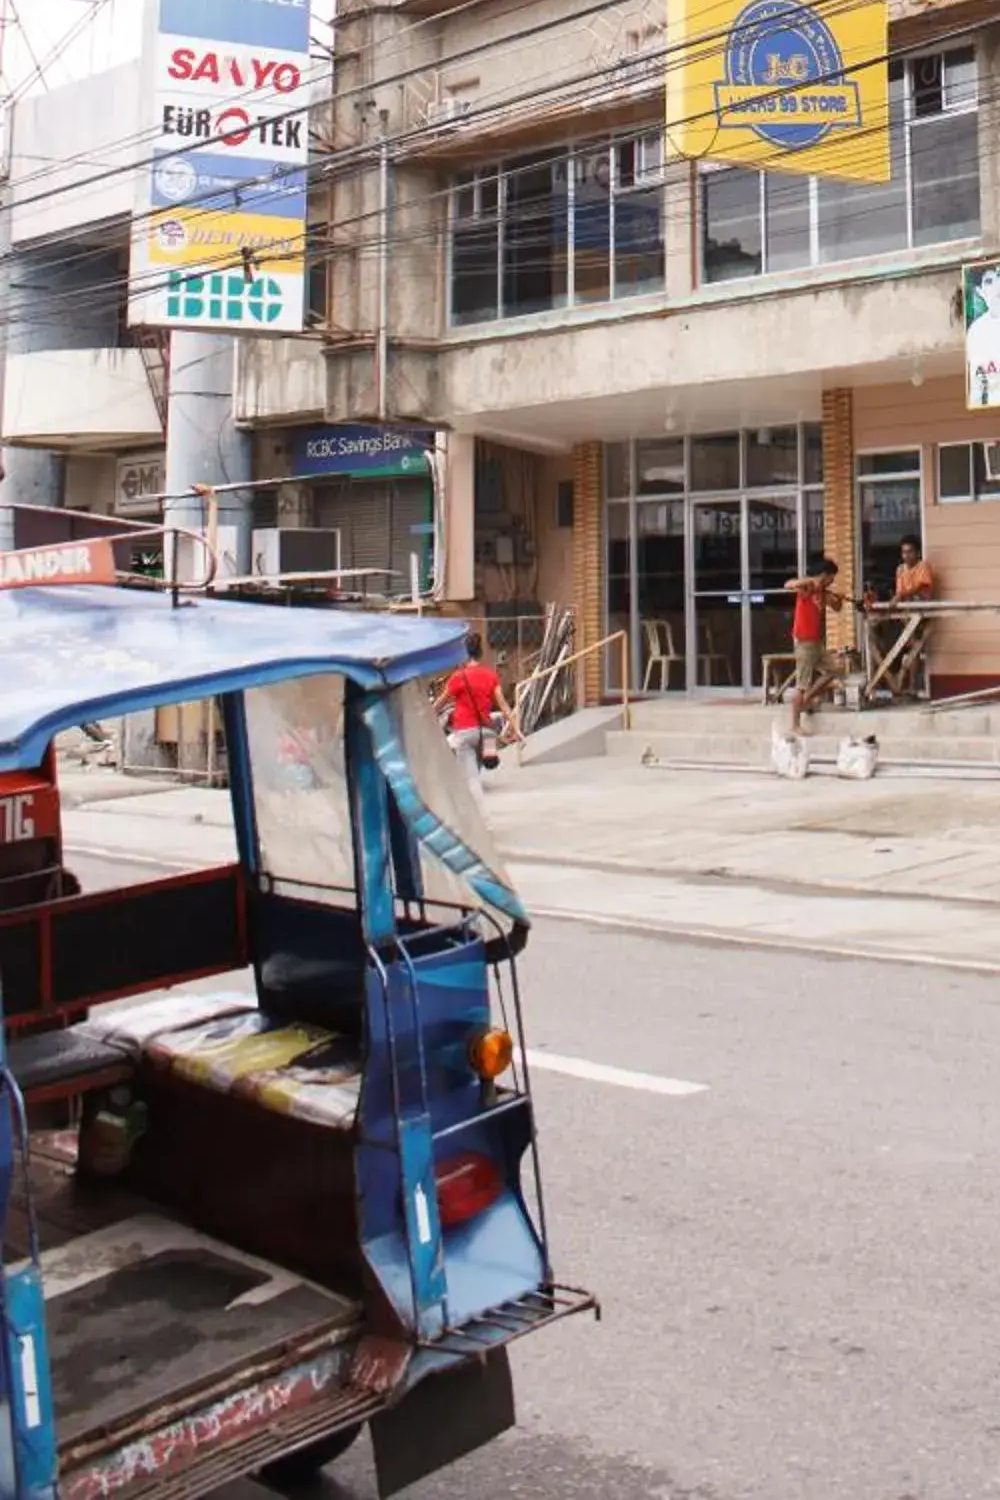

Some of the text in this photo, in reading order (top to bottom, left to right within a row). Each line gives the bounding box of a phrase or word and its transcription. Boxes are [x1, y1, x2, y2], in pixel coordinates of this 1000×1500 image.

[306, 432, 413, 458] RCBC Savings Bank
[0, 547, 92, 583] ANDER
